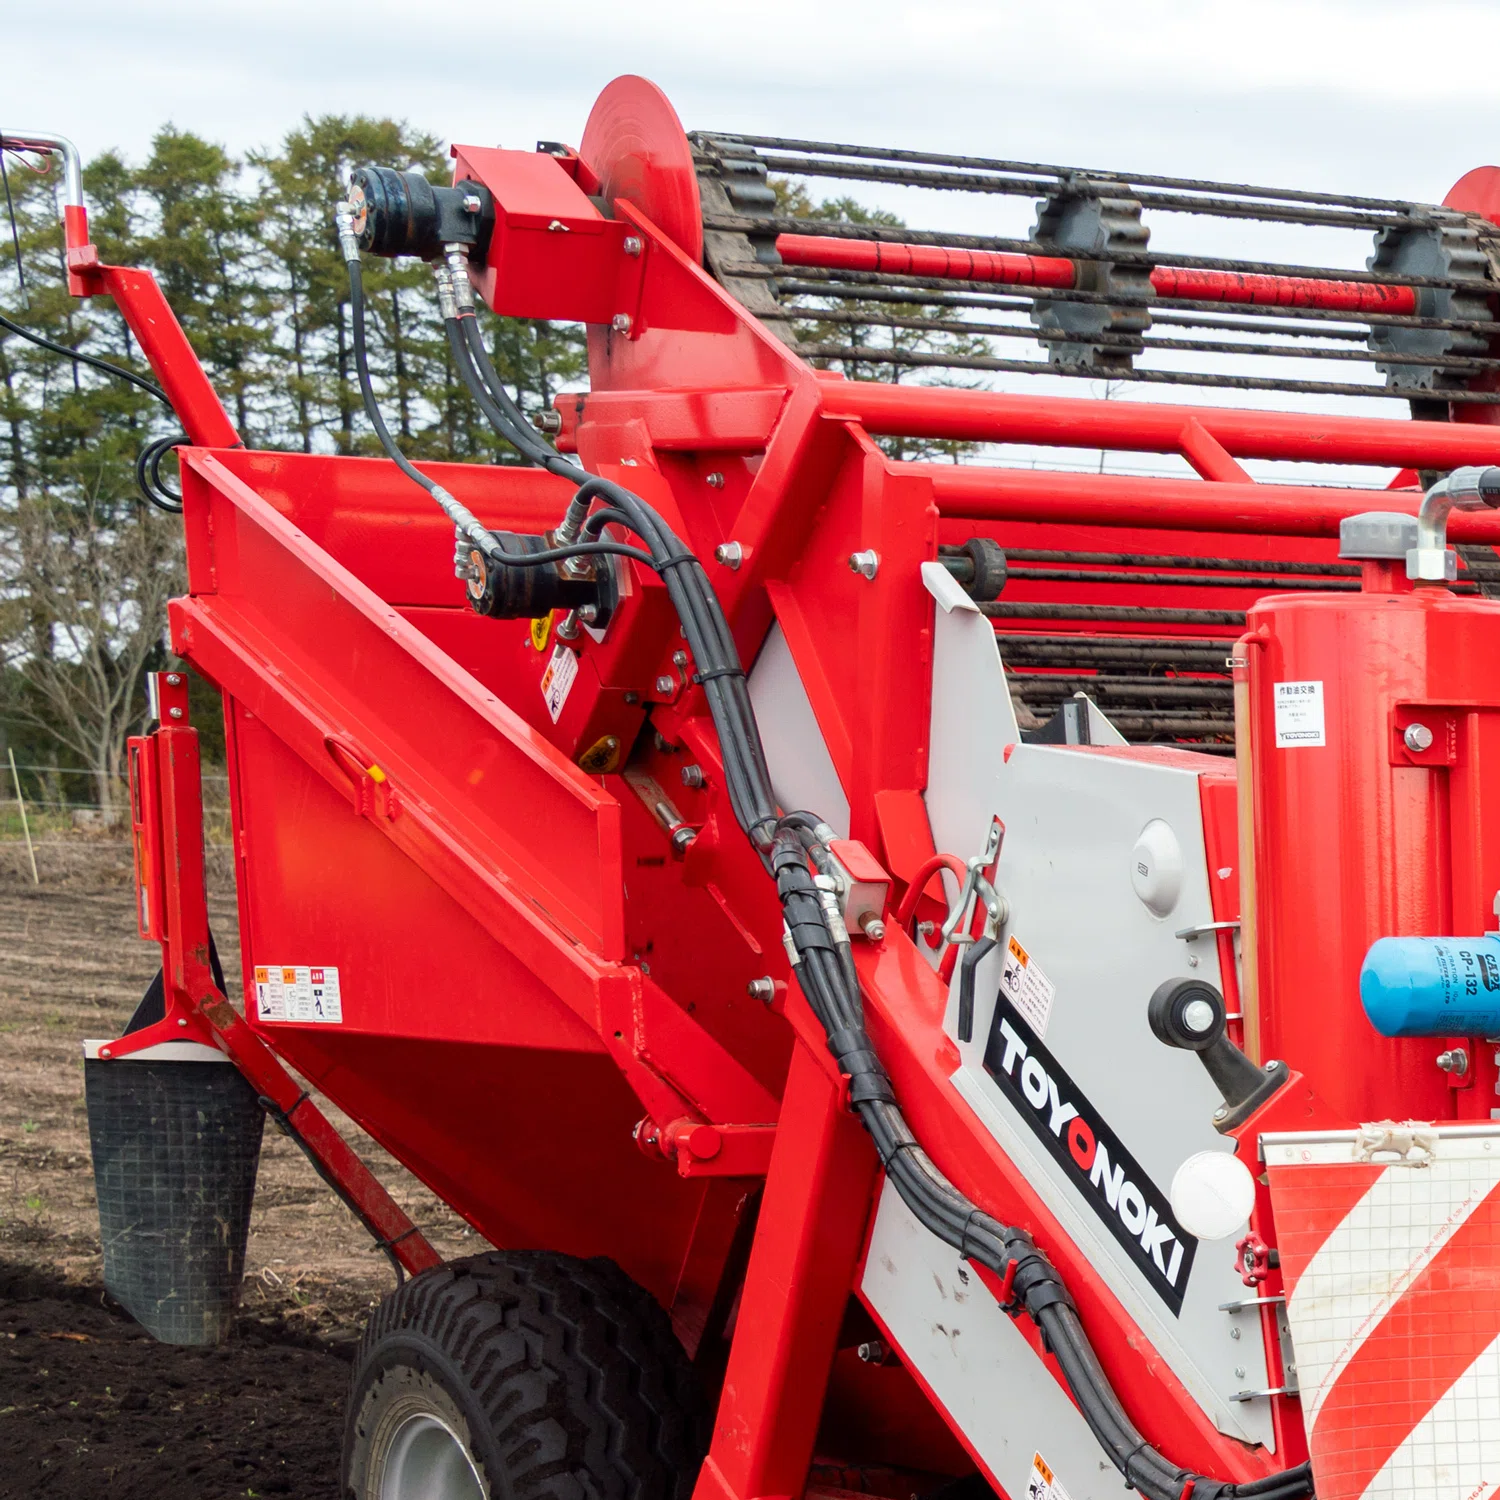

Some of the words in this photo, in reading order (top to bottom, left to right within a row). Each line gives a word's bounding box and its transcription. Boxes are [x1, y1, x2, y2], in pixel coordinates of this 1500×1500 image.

[1459, 951, 1477, 996] CP-132
[1485, 954, 1500, 991] CAPA
[1000, 1018, 1184, 1287] TOYONOKI
